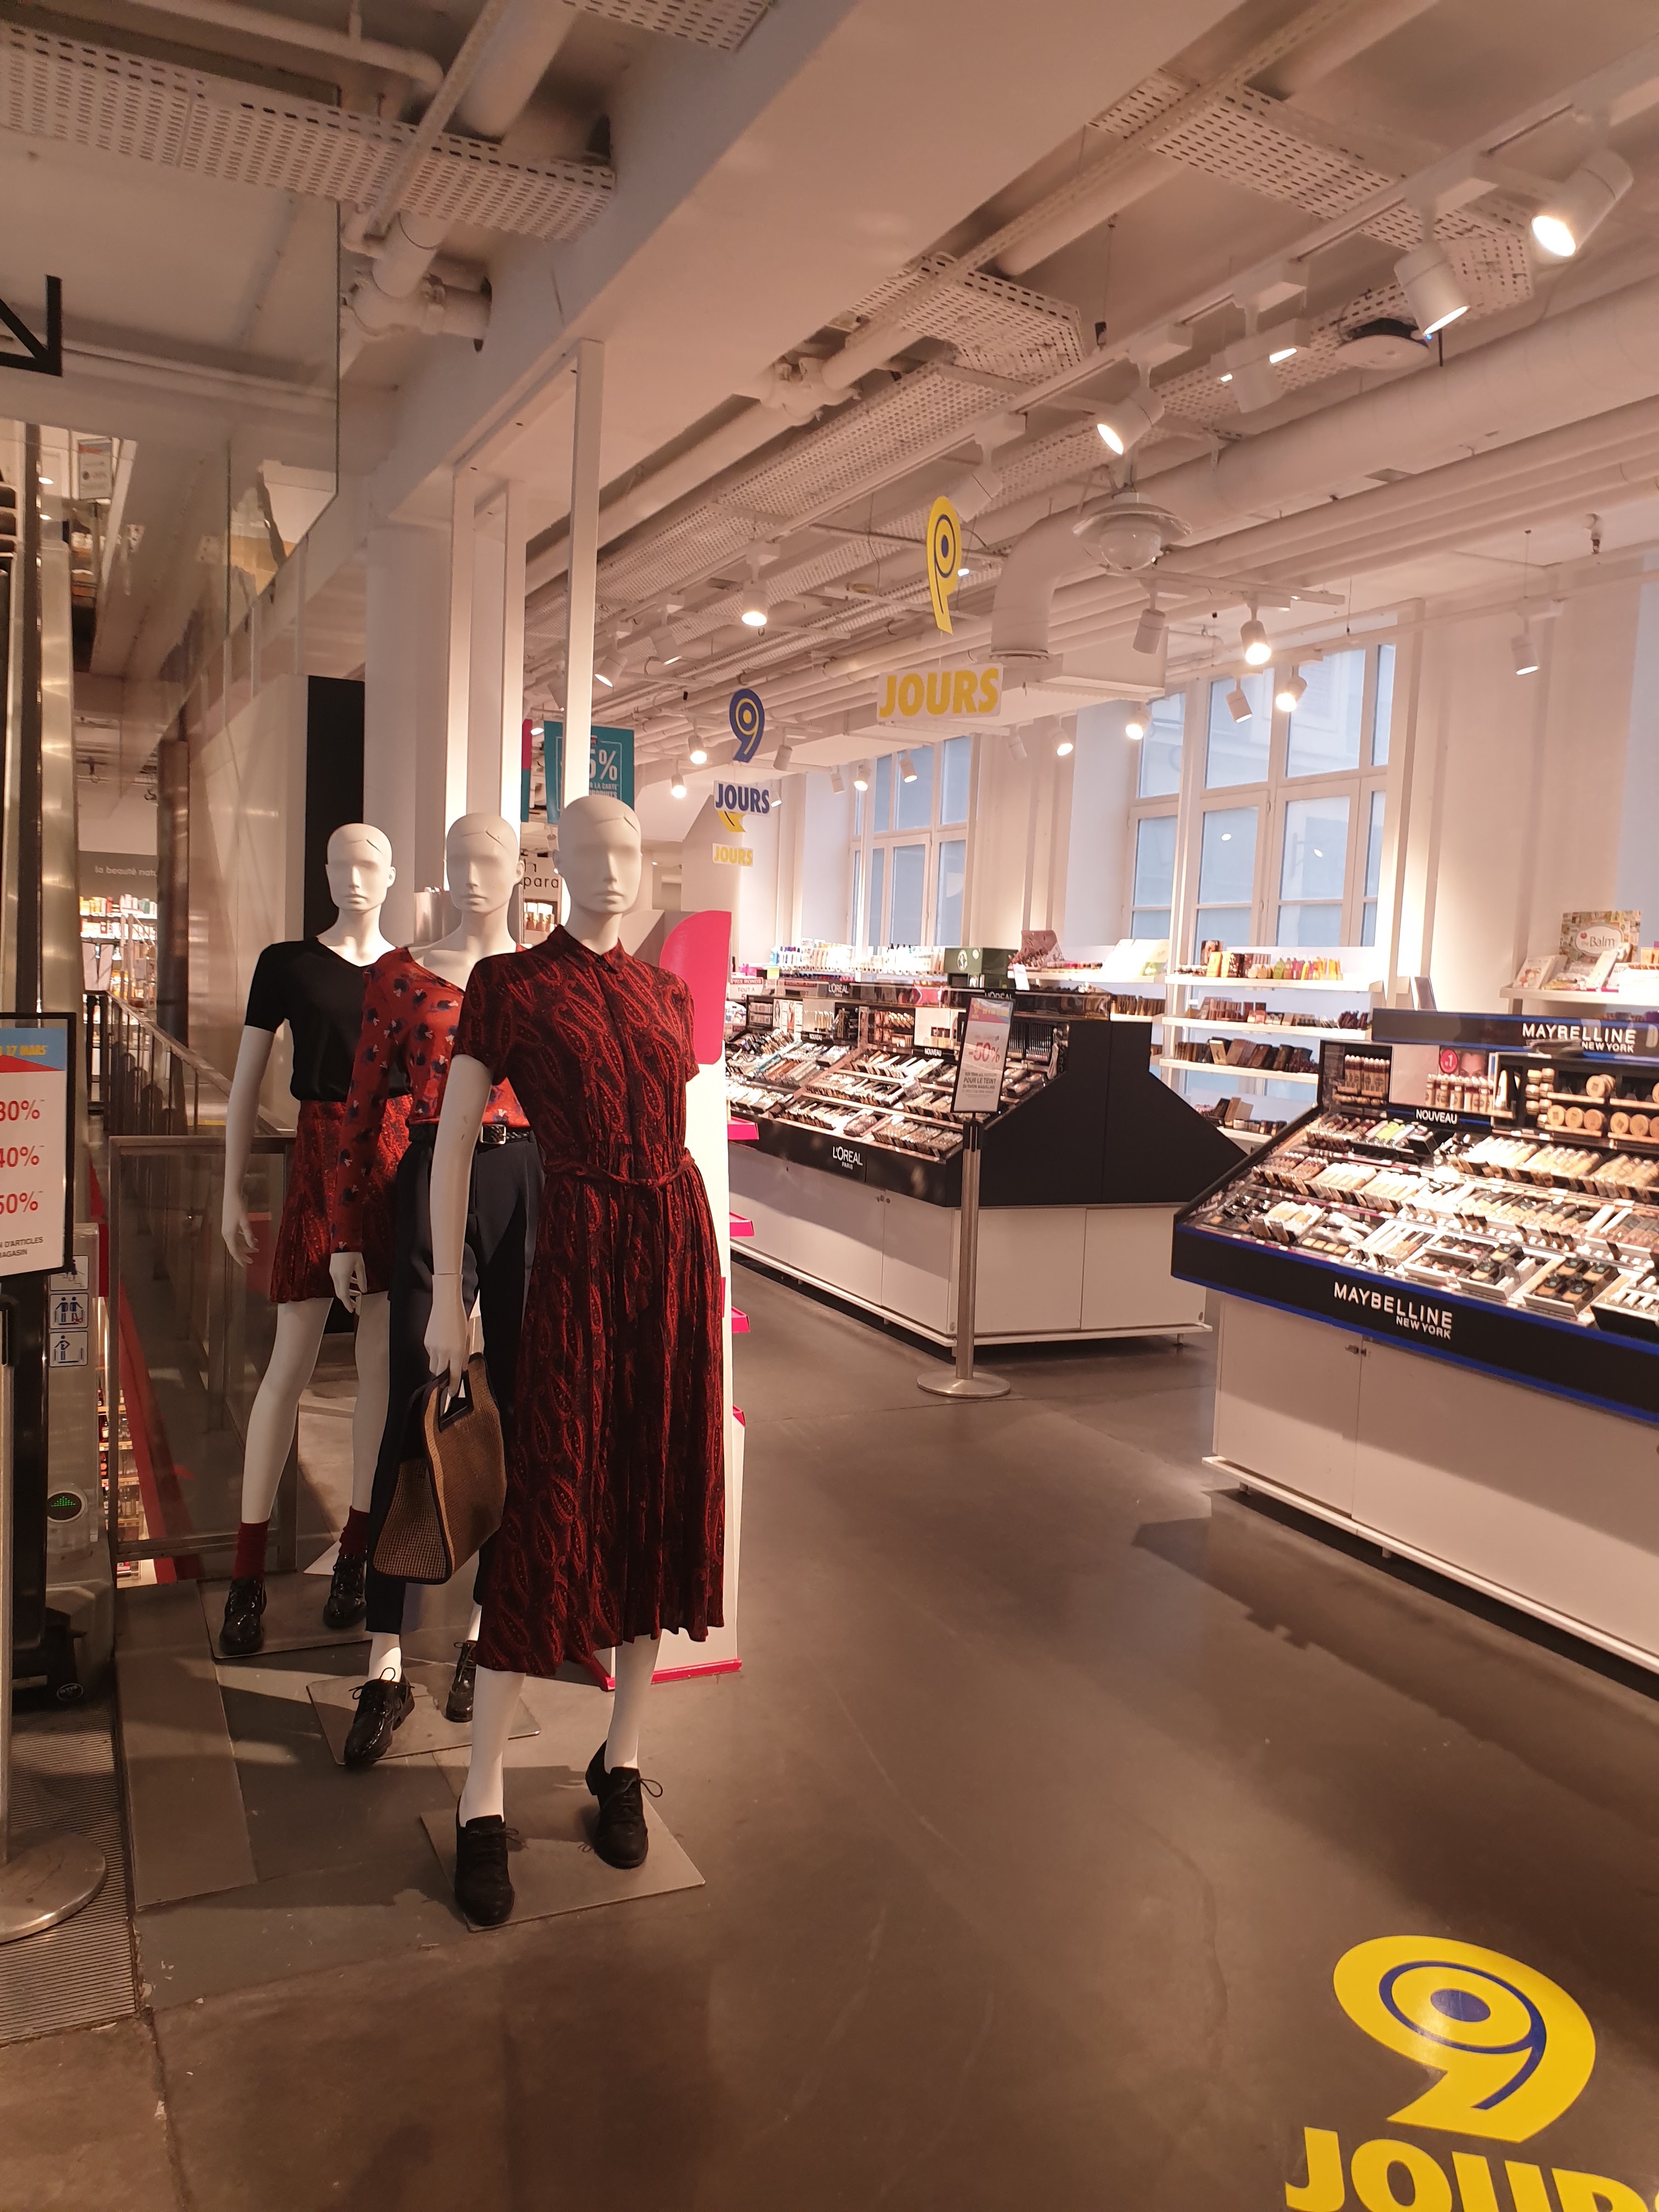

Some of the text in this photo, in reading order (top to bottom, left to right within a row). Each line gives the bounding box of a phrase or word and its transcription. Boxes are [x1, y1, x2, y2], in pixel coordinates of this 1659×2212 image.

[879, 668, 999, 718] JOURS
[730, 688, 765, 763] 9
[715, 783, 770, 814] JOURS
[714, 845, 753, 866] JOURS
[523, 877, 558, 889] para
[1522, 1023, 1637, 1044] MAYBELLINE
[924, 1048, 942, 1057] NOUVEAU
[968, 1042, 1000, 1063] -50%
[1582, 1041, 1634, 1053] NEW YORK
[1416, 1109, 1458, 1124] NOUVEAU
[5, 1237, 43, 1248] D'ARTICLES
[1334, 1282, 1453, 1330] MAYBELLINE
[1396, 1316, 1451, 1340] NEW YORK
[1334, 1936, 1596, 2143] 9
[1285, 2126, 1659, 2212] JOUR
